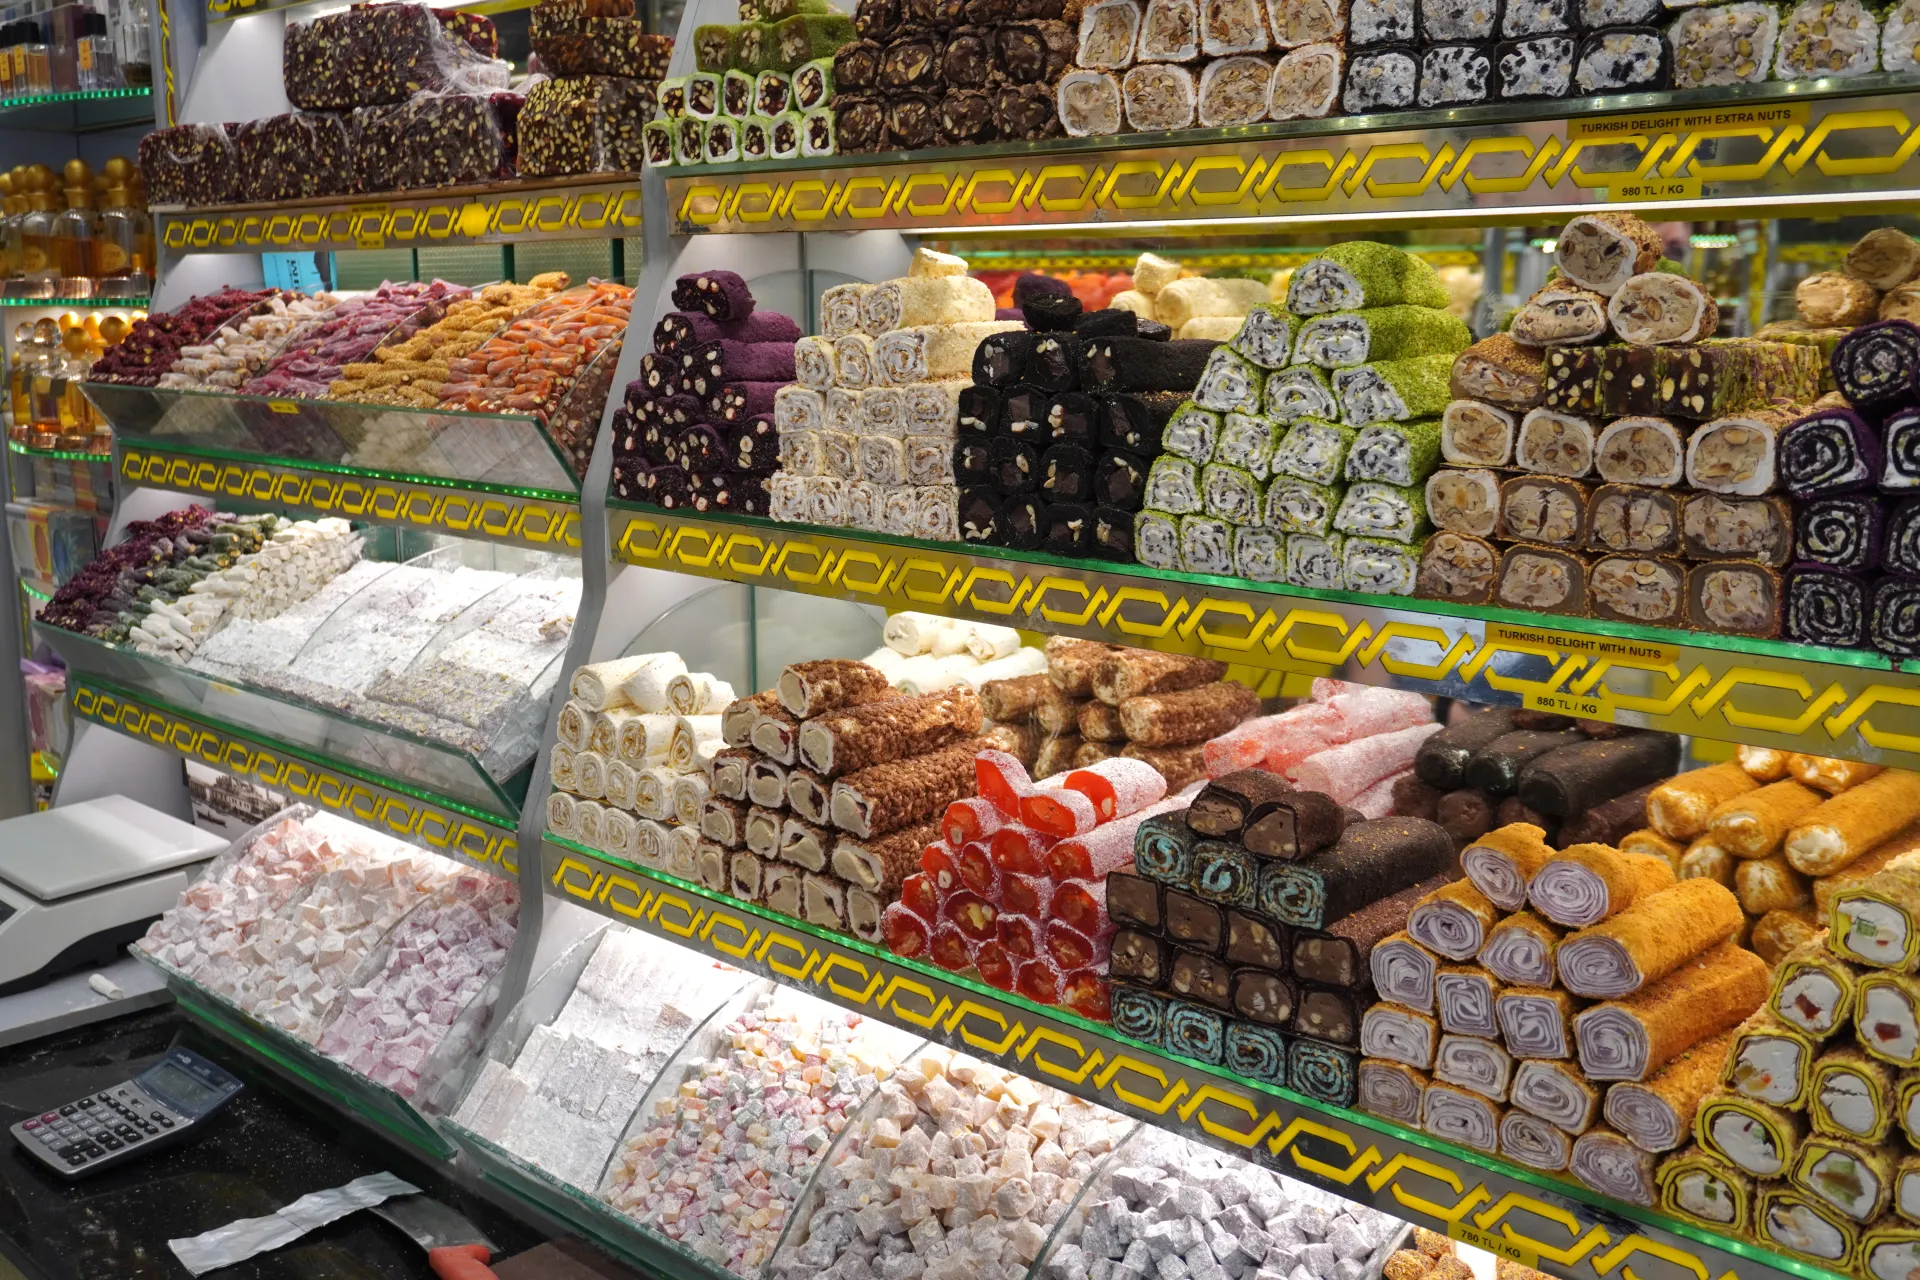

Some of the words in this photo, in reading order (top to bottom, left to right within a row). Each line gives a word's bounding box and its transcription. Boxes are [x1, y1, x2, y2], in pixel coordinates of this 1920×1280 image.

[1581, 121, 1628, 133] TURKISH
[1631, 117, 1680, 130] DELIGHT
[1684, 115, 1712, 127] WITH
[1715, 112, 1754, 124] EXTRA
[1758, 109, 1791, 121] NUTS
[1622, 187, 1641, 196] 980
[1644, 186, 1657, 195] TL
[1668, 185, 1684, 194] KG
[1498, 629, 1544, 644] TURKISH
[1547, 636, 1596, 650] DELIGHT
[1599, 642, 1626, 654] WITH
[1629, 646, 1661, 659] NUTS
[1536, 696, 1555, 707] 880
[1558, 700, 1571, 710] TL
[1581, 703, 1597, 714] KG
[1461, 1229, 1479, 1243] 780
[1482, 1237, 1495, 1249] TL
[1505, 1246, 1521, 1258] KG
